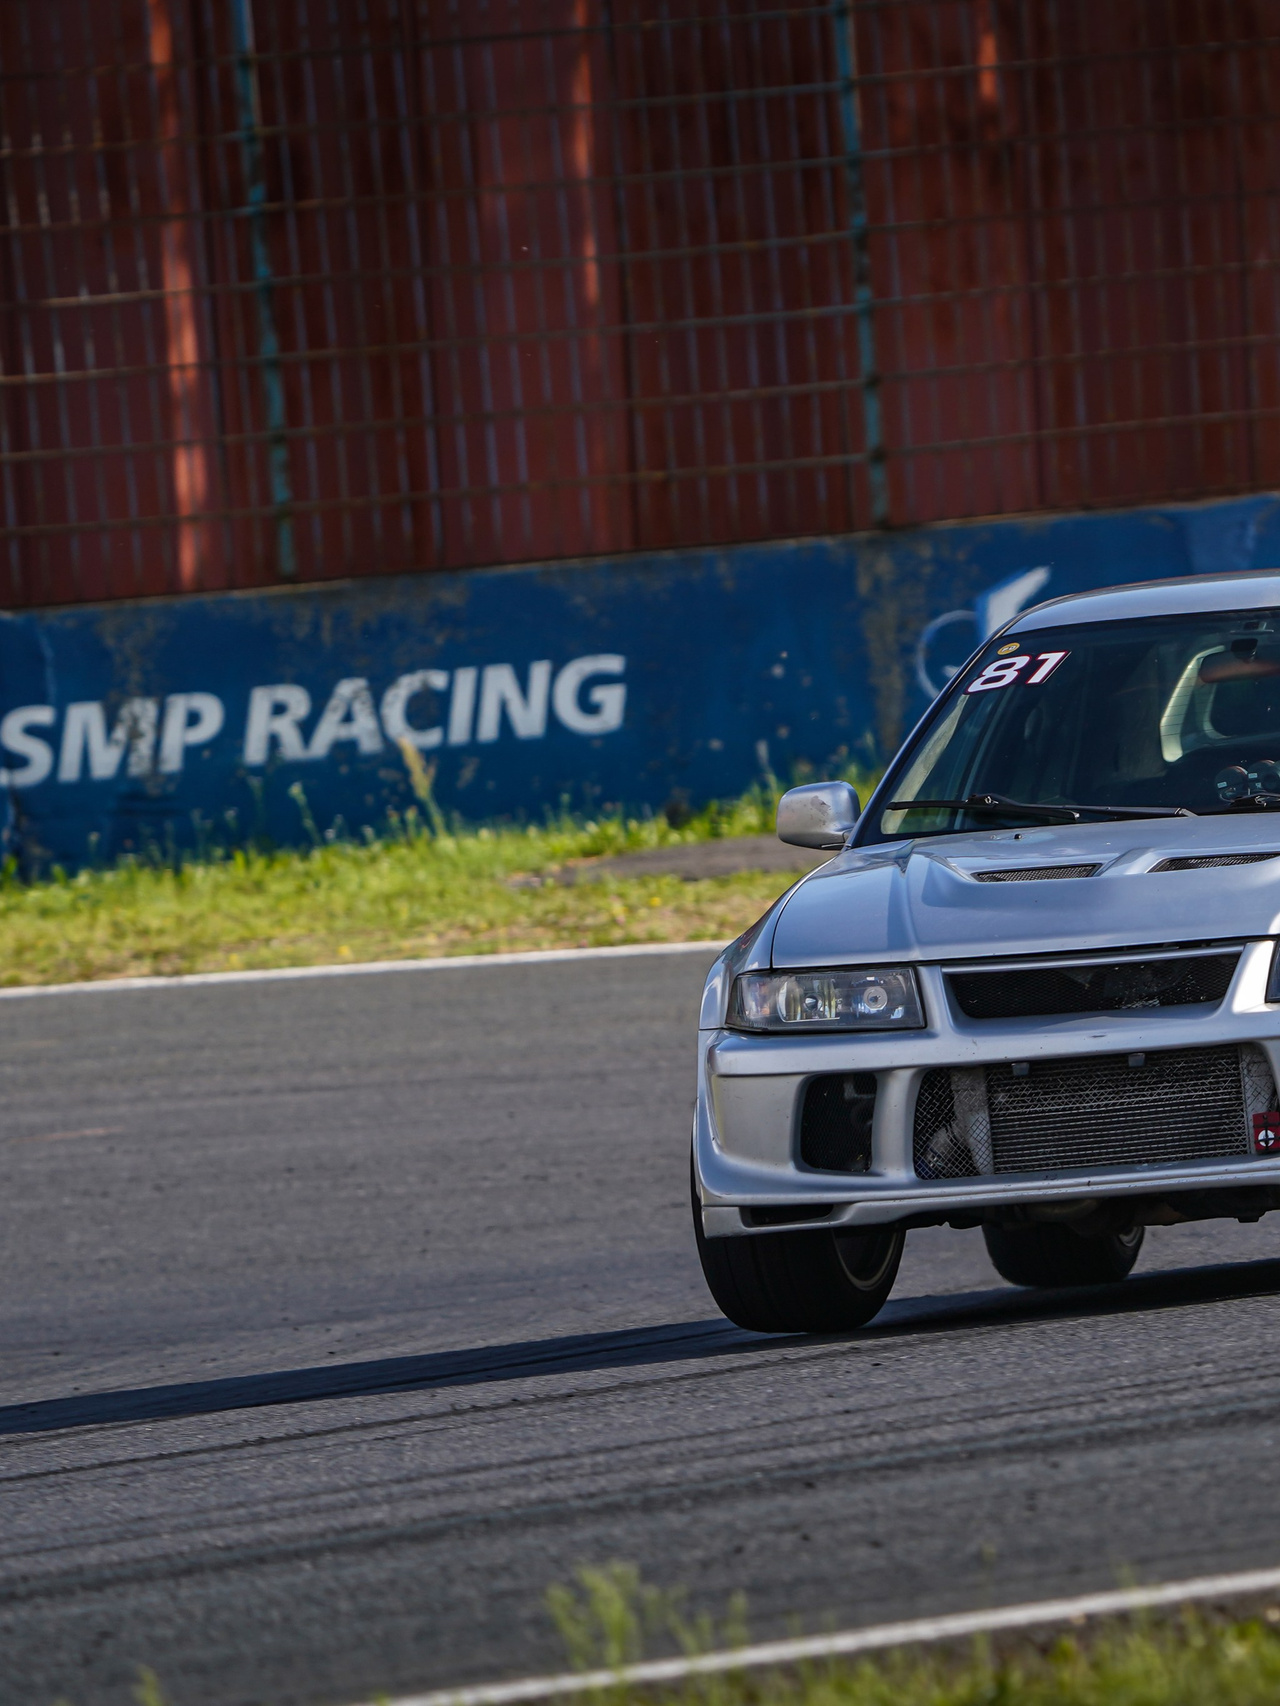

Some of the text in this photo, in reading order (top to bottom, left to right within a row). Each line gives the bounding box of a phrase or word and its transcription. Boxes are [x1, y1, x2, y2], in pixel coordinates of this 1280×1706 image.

[965, 650, 1069, 694] 81
[0, 653, 626, 787] SMP RACING
